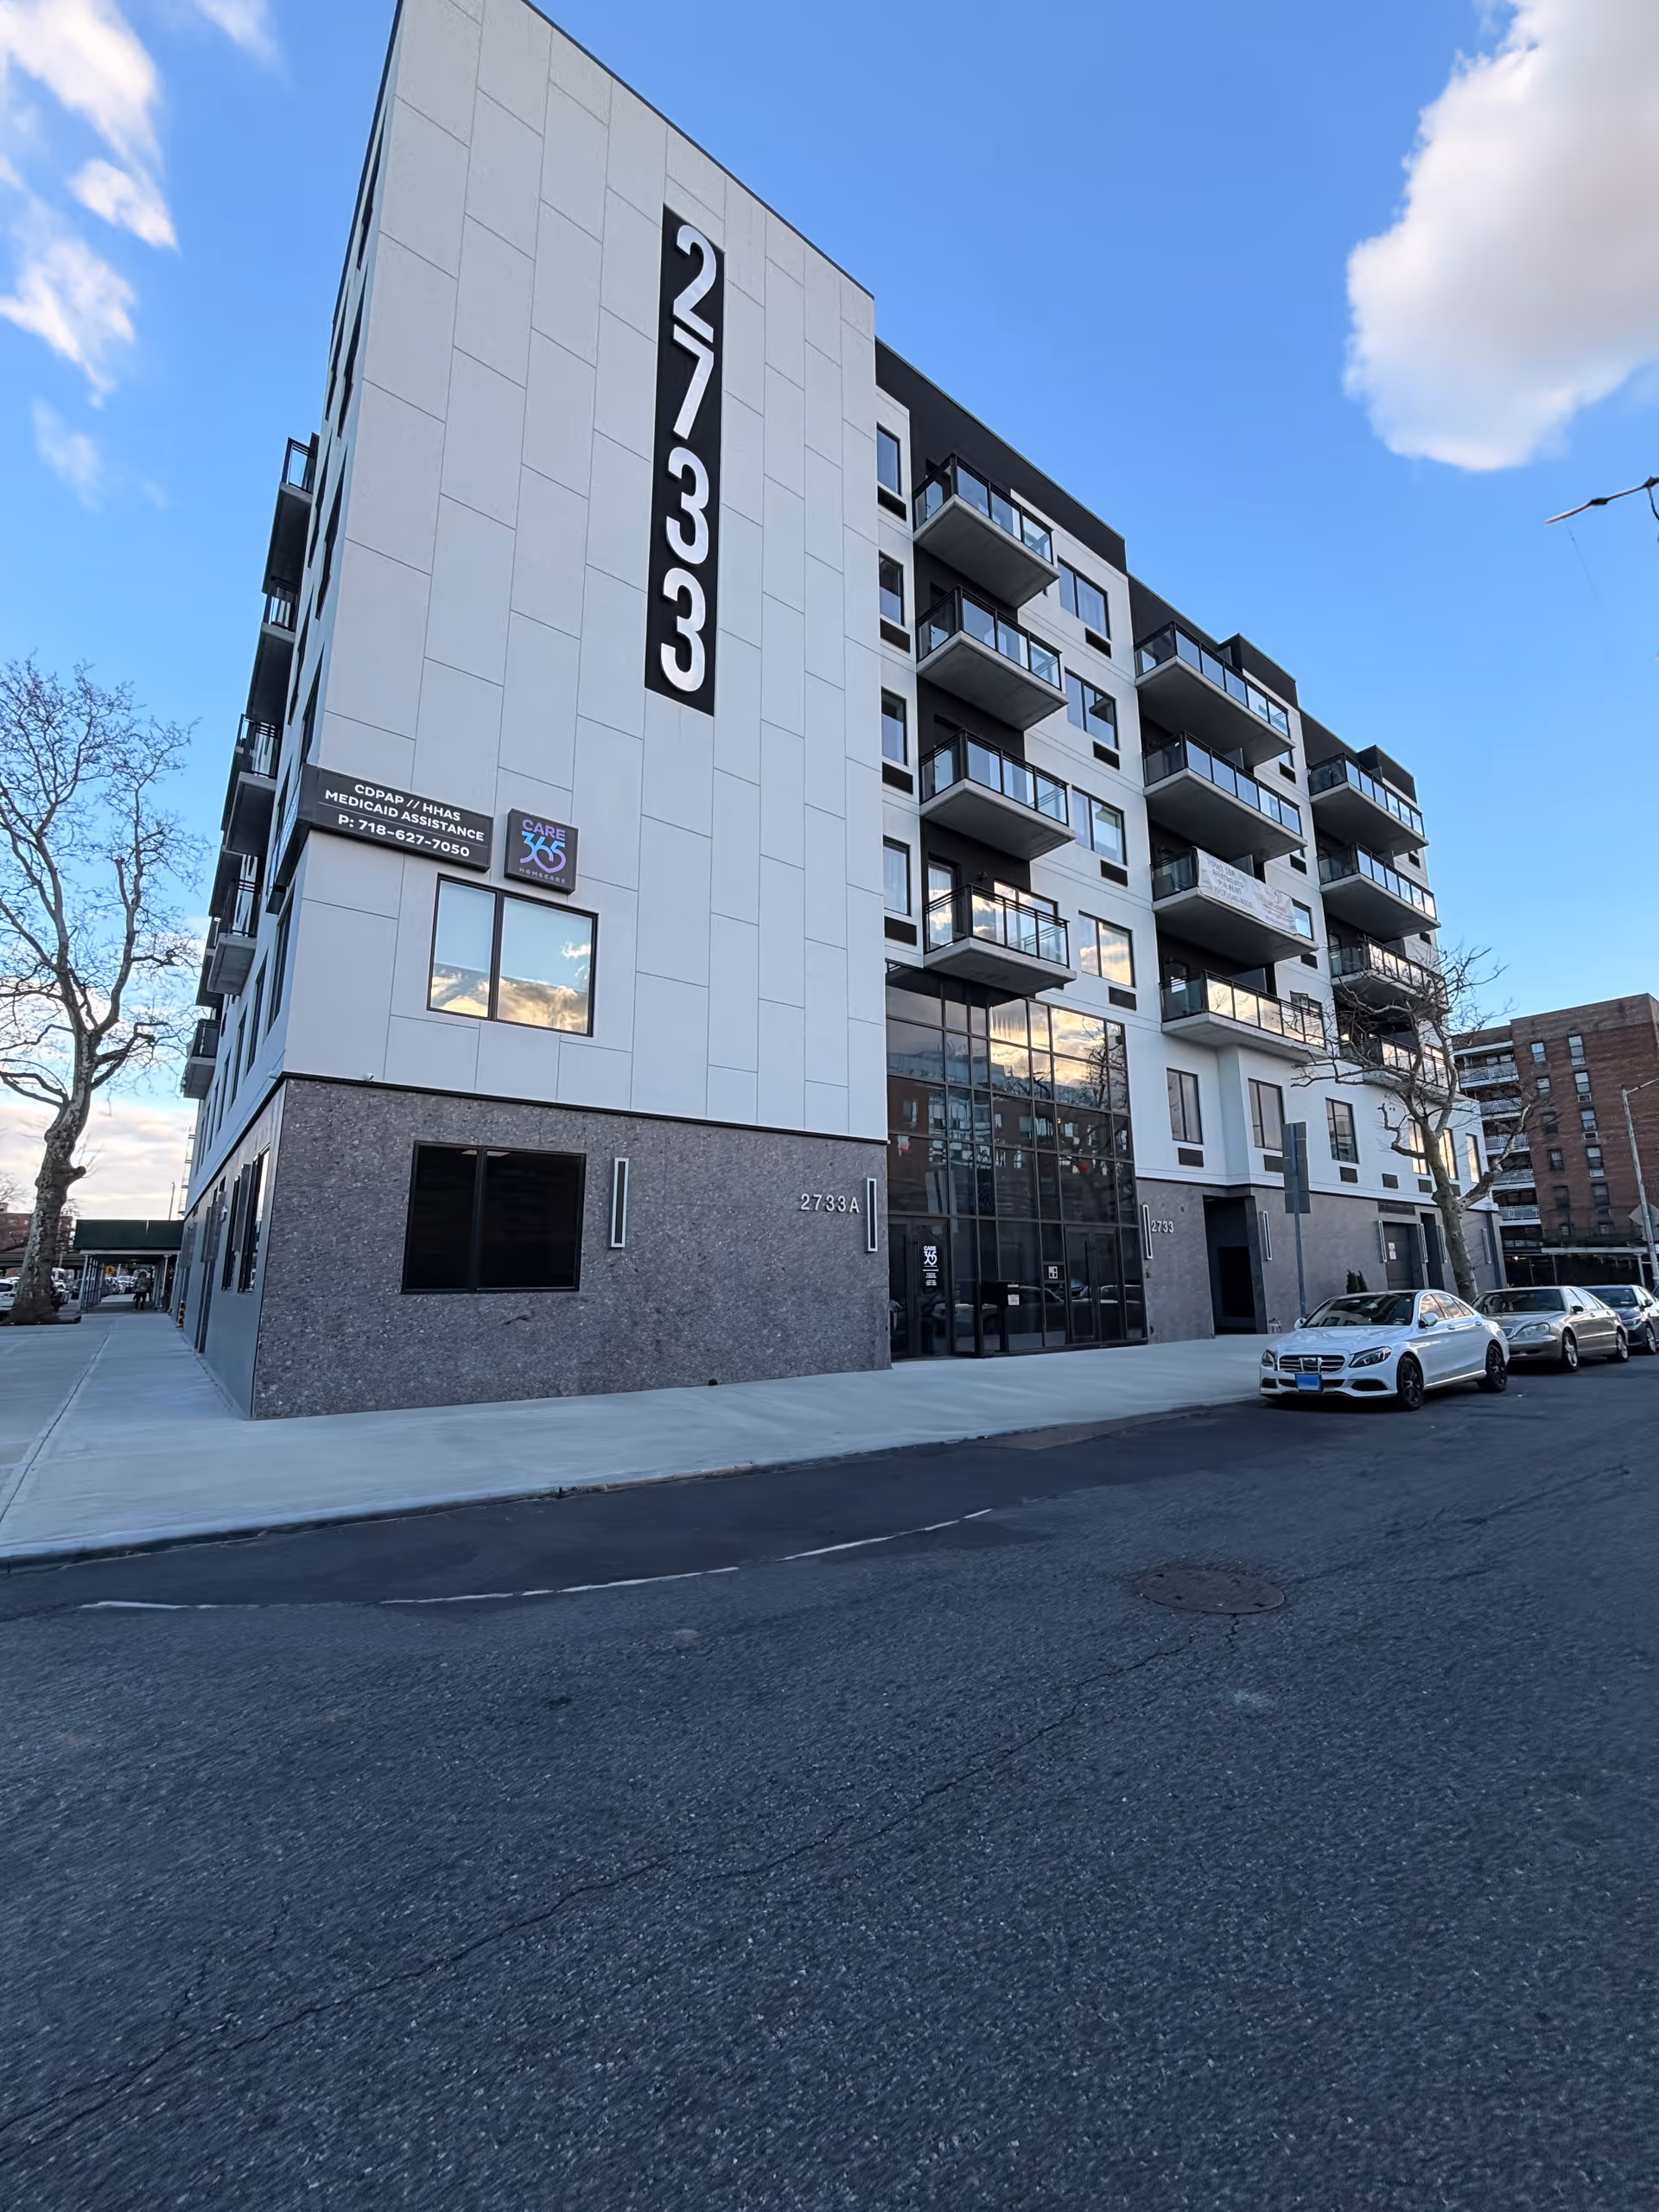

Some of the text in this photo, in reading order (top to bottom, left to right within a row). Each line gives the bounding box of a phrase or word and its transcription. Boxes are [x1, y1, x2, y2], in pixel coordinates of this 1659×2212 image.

[660, 224, 717, 693] 2733
[325, 789, 485, 842] MEDICAID ASSISTANCE
[354, 784, 404, 804] CDPAP
[423, 803, 461, 821] HHAS
[338, 814, 470, 857] P: 718-627-7050
[522, 818, 566, 842] CARE
[519, 830, 567, 874] 365
[518, 867, 566, 884] HOMECARE
[800, 1192, 861, 1213] 2733A
[1151, 1219, 1174, 1233] 2733
